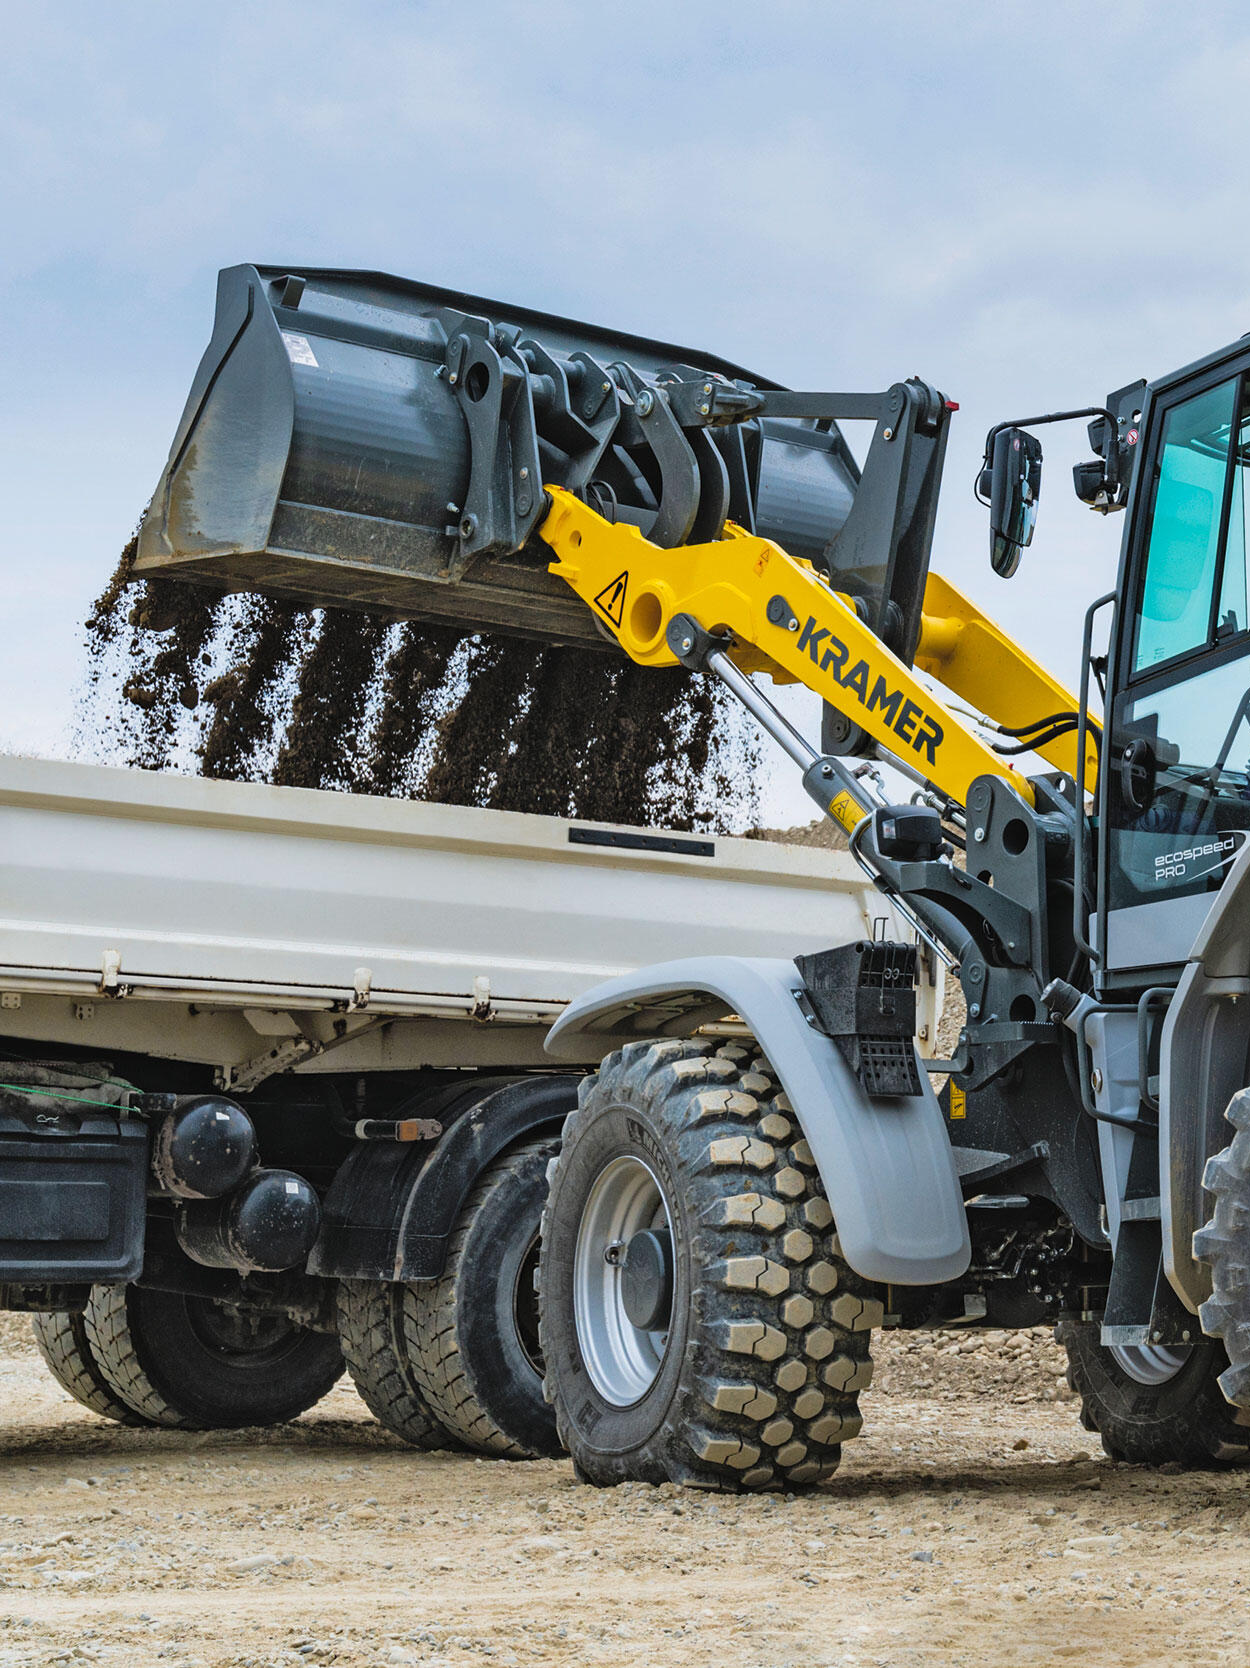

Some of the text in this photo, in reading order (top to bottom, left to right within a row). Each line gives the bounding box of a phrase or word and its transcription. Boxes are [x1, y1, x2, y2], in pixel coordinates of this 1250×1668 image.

[796, 615, 944, 767] KRAMER
[1155, 836, 1234, 867] ecospeed
[1155, 864, 1186, 882] PRO
